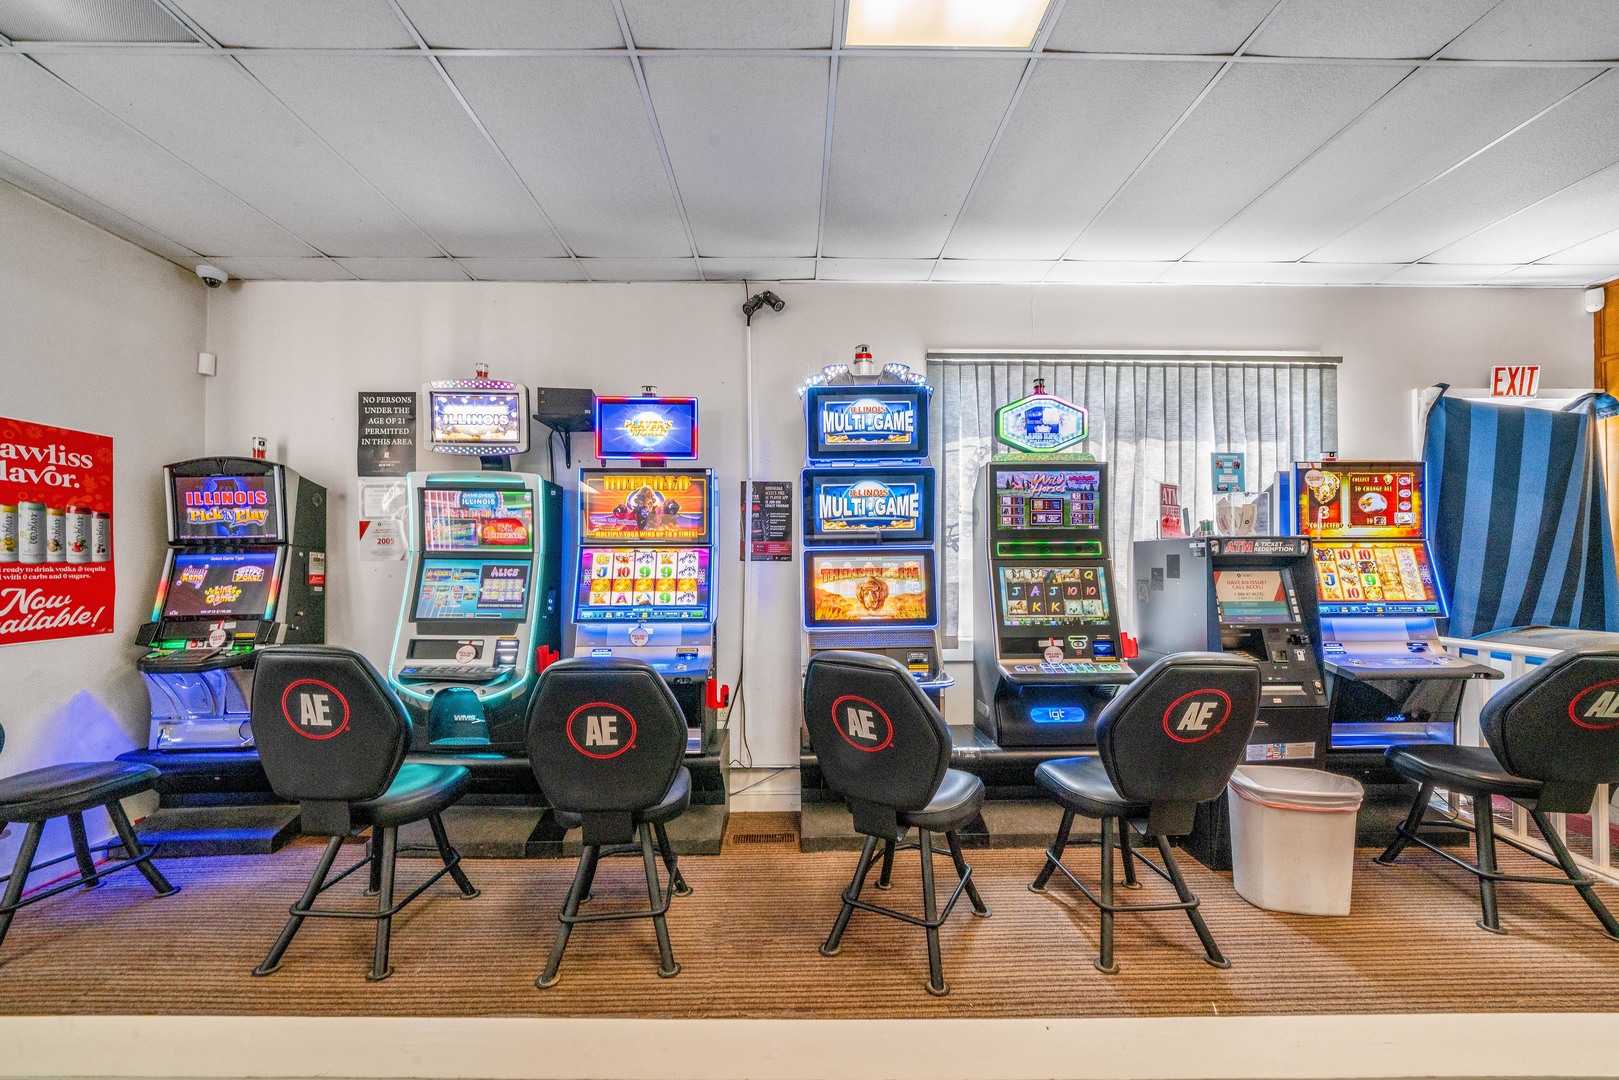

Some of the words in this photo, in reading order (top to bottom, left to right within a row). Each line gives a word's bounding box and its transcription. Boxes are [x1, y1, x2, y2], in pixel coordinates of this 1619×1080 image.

[1493, 366, 1539, 396] EXIT
[364, 406, 393, 414] UNDER
[393, 406, 410, 414] THE
[849, 405, 886, 413] ILLINOIS
[368, 417, 385, 425] AGE
[385, 417, 397, 425] OF
[397, 417, 406, 425] 21
[443, 413, 510, 425] ILLINOIS
[623, 419, 674, 429] PLAYER'S
[629, 428, 669, 437] WORLD
[1033, 473, 1065, 486] Wild
[849, 488, 889, 497] ILLINOIS
[1031, 484, 1067, 498] Horses
[185, 490, 268, 506] ILLINOIS
[189, 507, 223, 522] Pick
[234, 507, 268, 525] Play
[1318, 505, 1330, 520] 3
[1309, 522, 1340, 530] COLLECTED
[595, 530, 622, 538] MULTIPLY
[623, 530, 639, 538] YOUR
[640, 530, 655, 538] WINS
[655, 530, 663, 538] UP
[665, 530, 672, 538] TO
[1224, 540, 1254, 553] ATM
[595, 554, 610, 566] Q
[660, 553, 674, 565] K
[1337, 549, 1351, 560] 10
[1358, 549, 1372, 560] 10
[2, 566, 25, 574] ready
[84, 565, 106, 574] tequila
[596, 566, 608, 578] J
[617, 566, 631, 578] 10
[639, 566, 651, 578] 9
[660, 566, 673, 578] 9
[1321, 562, 1335, 574] K
[181, 572, 204, 582] Keno
[1083, 570, 1094, 581] Q
[1324, 574, 1336, 586] J
[1364, 574, 1377, 586] 9
[1011, 586, 1022, 596] J
[1030, 586, 1040, 597] A
[1049, 586, 1059, 596] J
[1067, 586, 1078, 596] 10
[1086, 586, 1097, 596] 10
[1327, 587, 1340, 599] K
[1346, 587, 1360, 599] 10
[0, 588, 72, 617] Now
[593, 593, 608, 604] K
[615, 593, 628, 604] A
[659, 592, 671, 604] 9
[1032, 602, 1041, 613] K
[1051, 602, 1061, 613] K
[300, 693, 332, 726] AE
[1048, 709, 1066, 720] igt
[453, 714, 477, 722] WMS
[1176, 702, 1218, 731] AE
[847, 706, 878, 741] AE
[585, 715, 618, 746] AE
